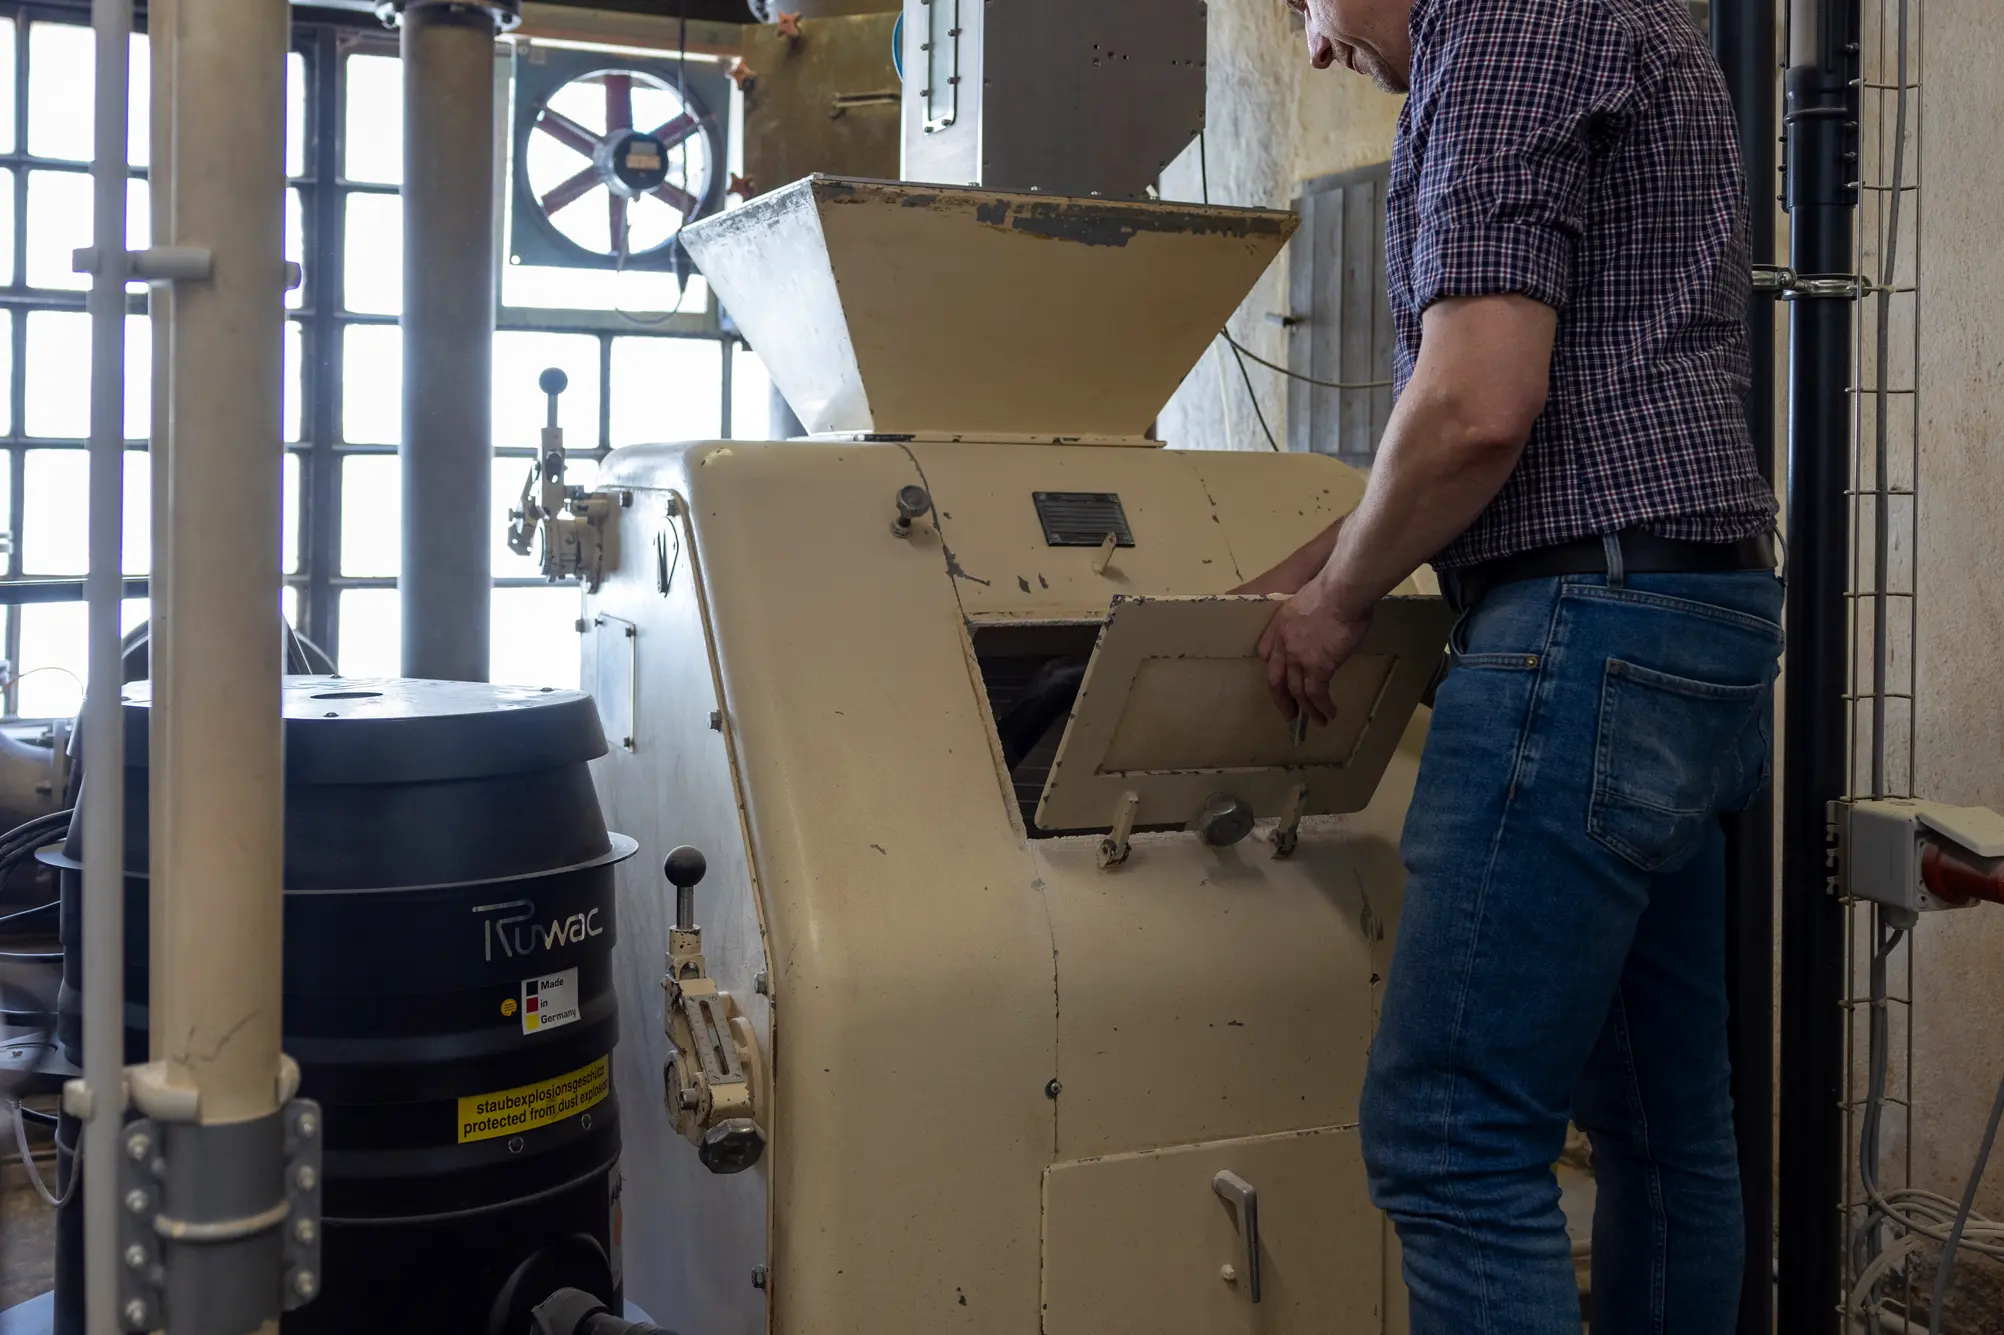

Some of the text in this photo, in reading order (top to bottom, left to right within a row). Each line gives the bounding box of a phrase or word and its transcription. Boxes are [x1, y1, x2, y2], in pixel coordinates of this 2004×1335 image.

[541, 978, 564, 991] Made
[540, 998, 548, 1008] in
[540, 1008, 577, 1024] Germany
[463, 1109, 527, 1138] protected
[530, 1103, 556, 1121] from
[558, 1094, 579, 1113] dust
